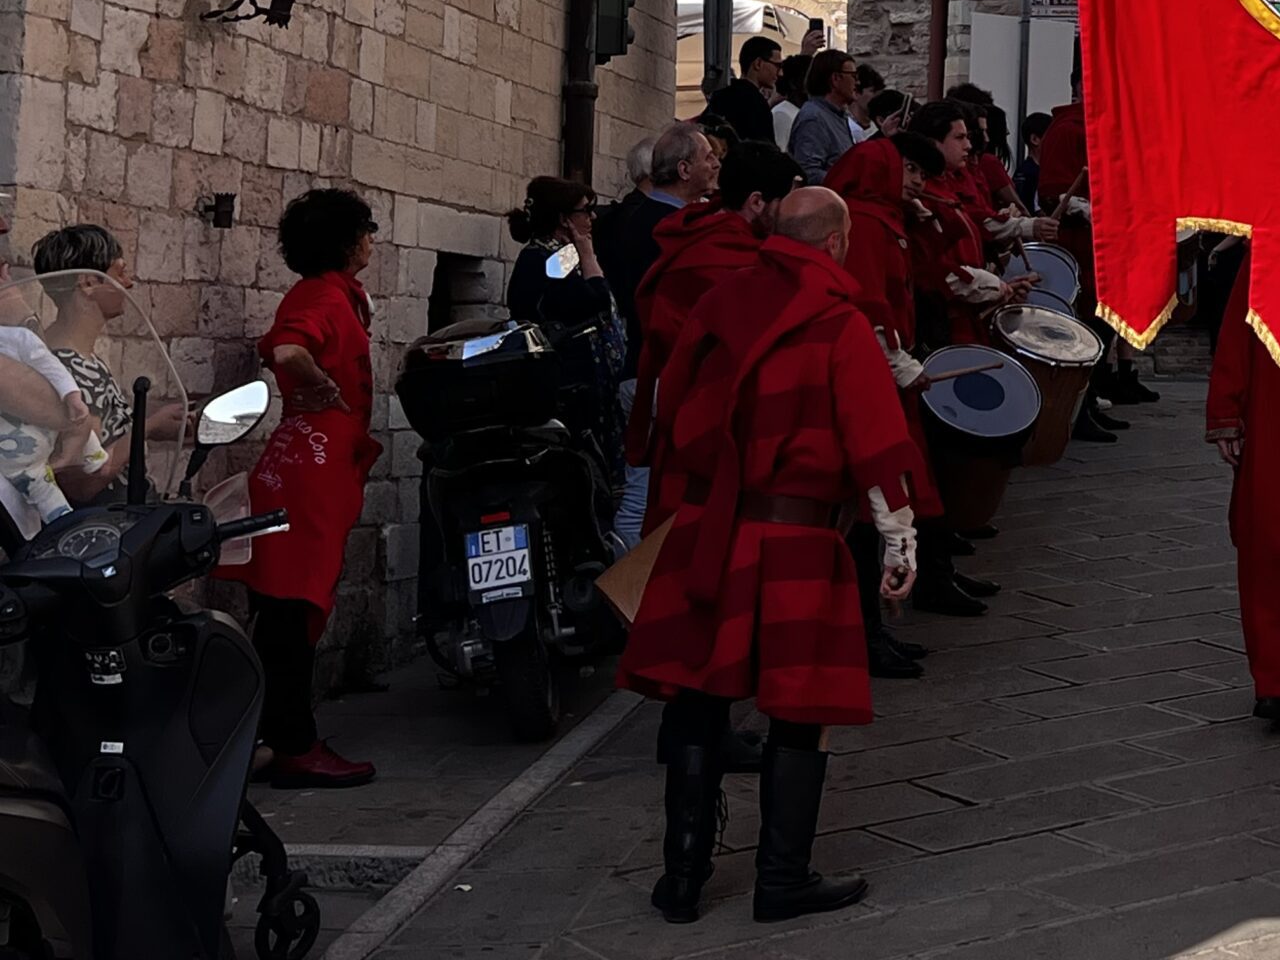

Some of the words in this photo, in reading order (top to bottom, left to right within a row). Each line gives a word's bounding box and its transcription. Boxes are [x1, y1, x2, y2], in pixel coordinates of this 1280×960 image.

[308, 431, 329, 465] Coro
[481, 529, 503, 554] ET
[471, 554, 529, 585] 07204
